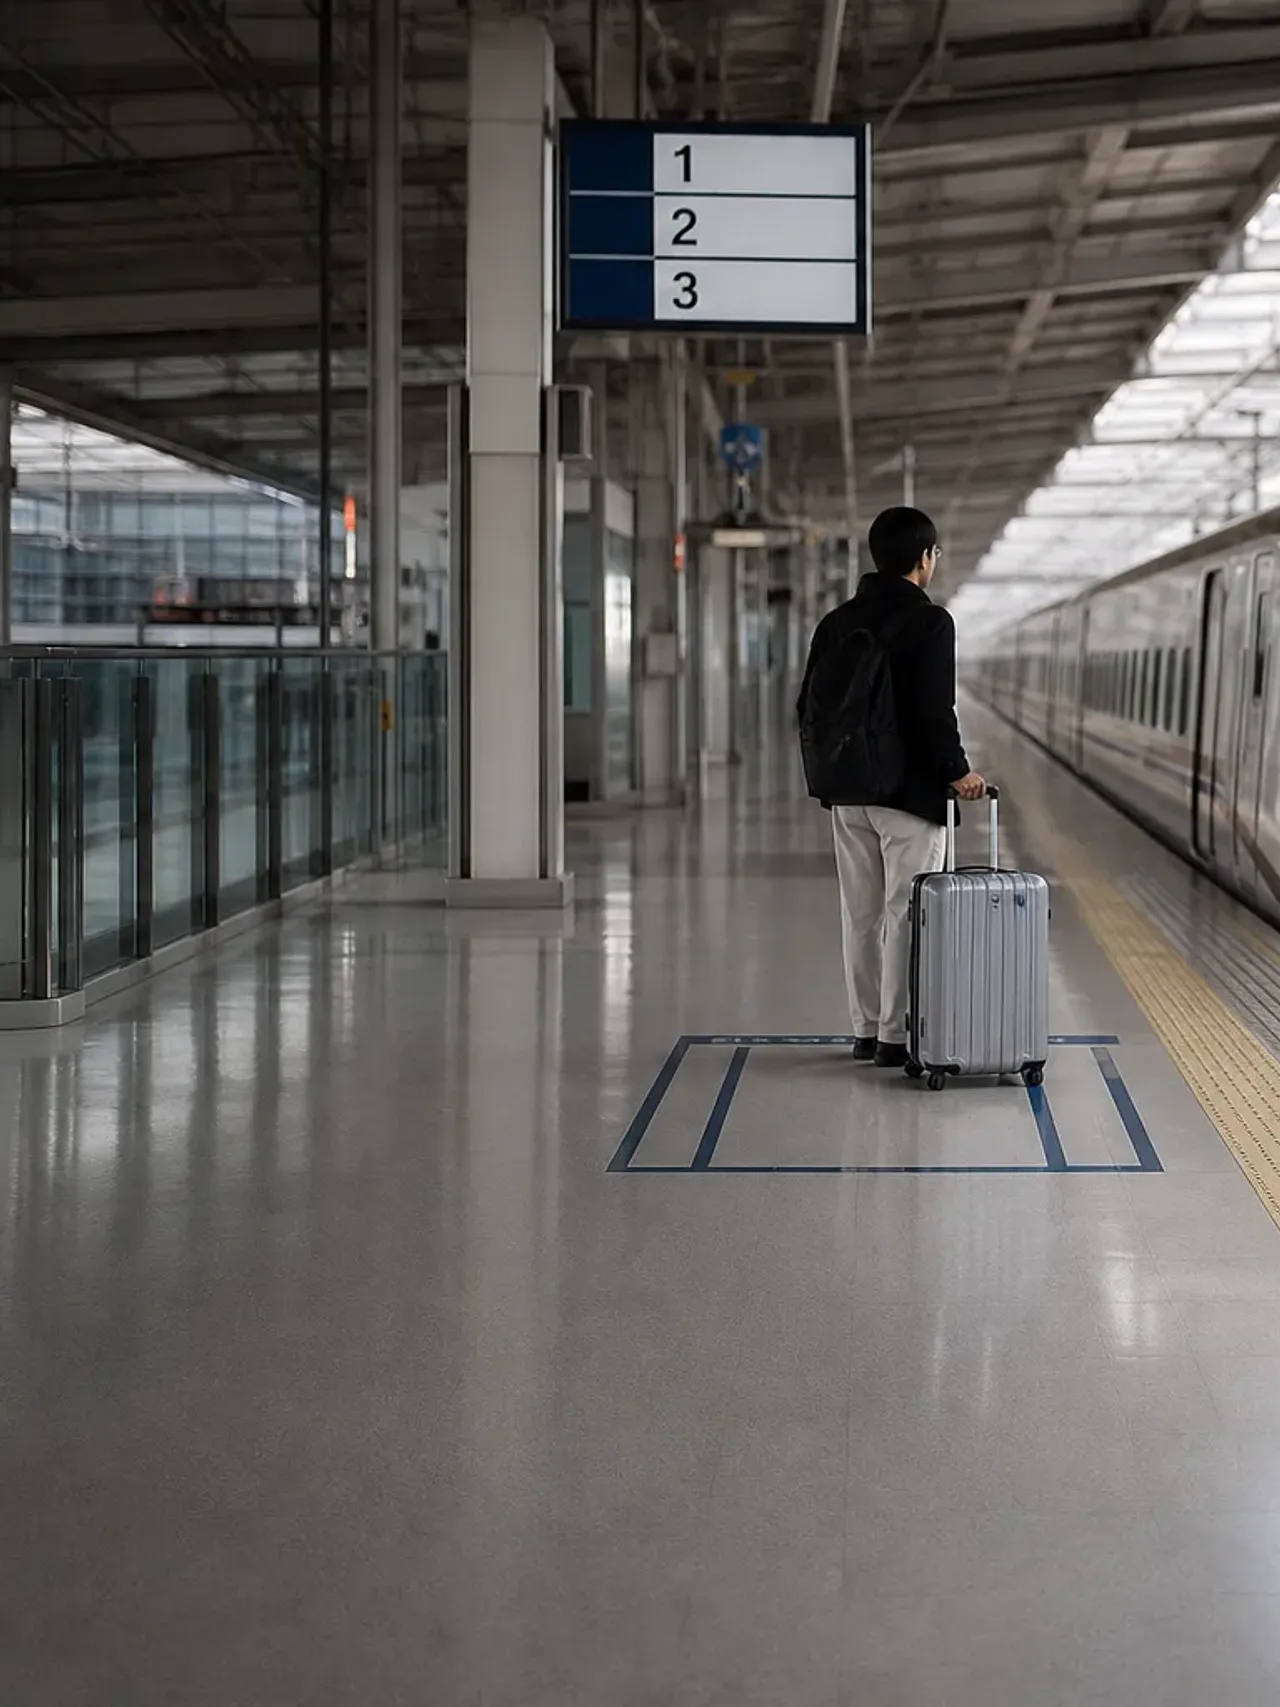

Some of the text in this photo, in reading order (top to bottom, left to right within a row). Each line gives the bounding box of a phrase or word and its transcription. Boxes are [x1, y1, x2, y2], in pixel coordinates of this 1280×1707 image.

[674, 145, 692, 183] 1
[671, 208, 698, 246] 2
[672, 271, 698, 310] 3
